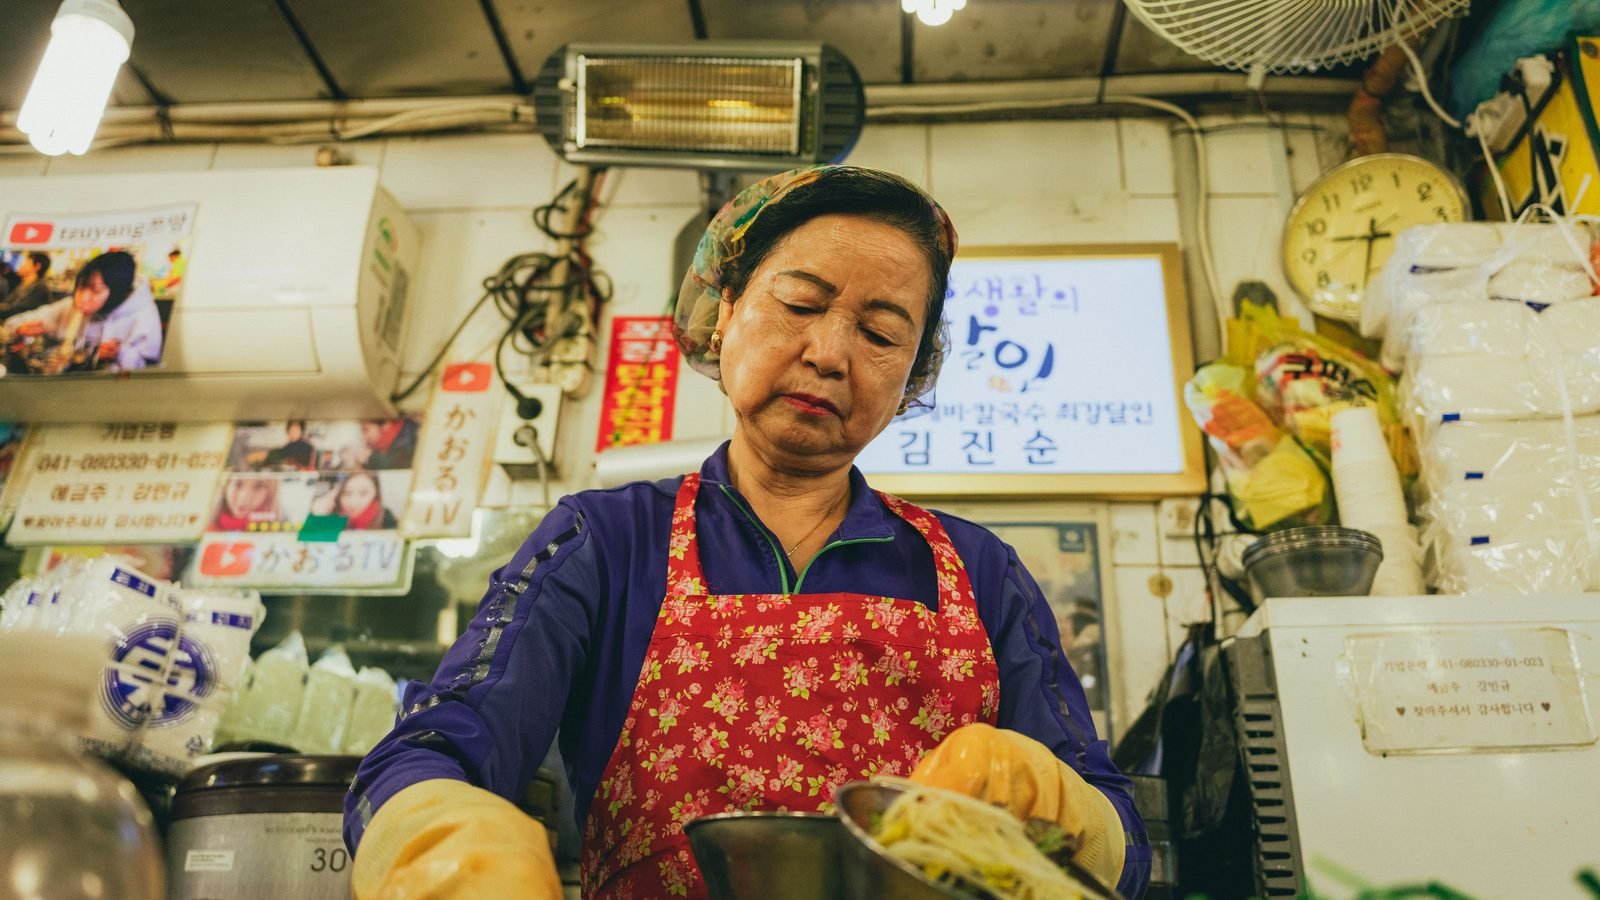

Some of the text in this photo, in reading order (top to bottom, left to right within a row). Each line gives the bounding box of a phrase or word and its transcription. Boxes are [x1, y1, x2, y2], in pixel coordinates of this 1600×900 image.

[1350, 173, 1372, 194] 12
[1417, 182, 1432, 201] 2
[1322, 193, 1341, 212] 11
[1307, 217, 1327, 236] 10
[1302, 248, 1316, 264] 9
[1318, 270, 1330, 289] 8
[964, 274, 1079, 318] 생활의
[1056, 401, 1154, 425] 최강달인
[900, 430, 1058, 466] 김 진 순
[51, 482, 108, 501] 예금주
[261, 543, 398, 573] かおるTV
[1478, 703, 1535, 716] 감사합니다
[311, 848, 347, 872] 30
